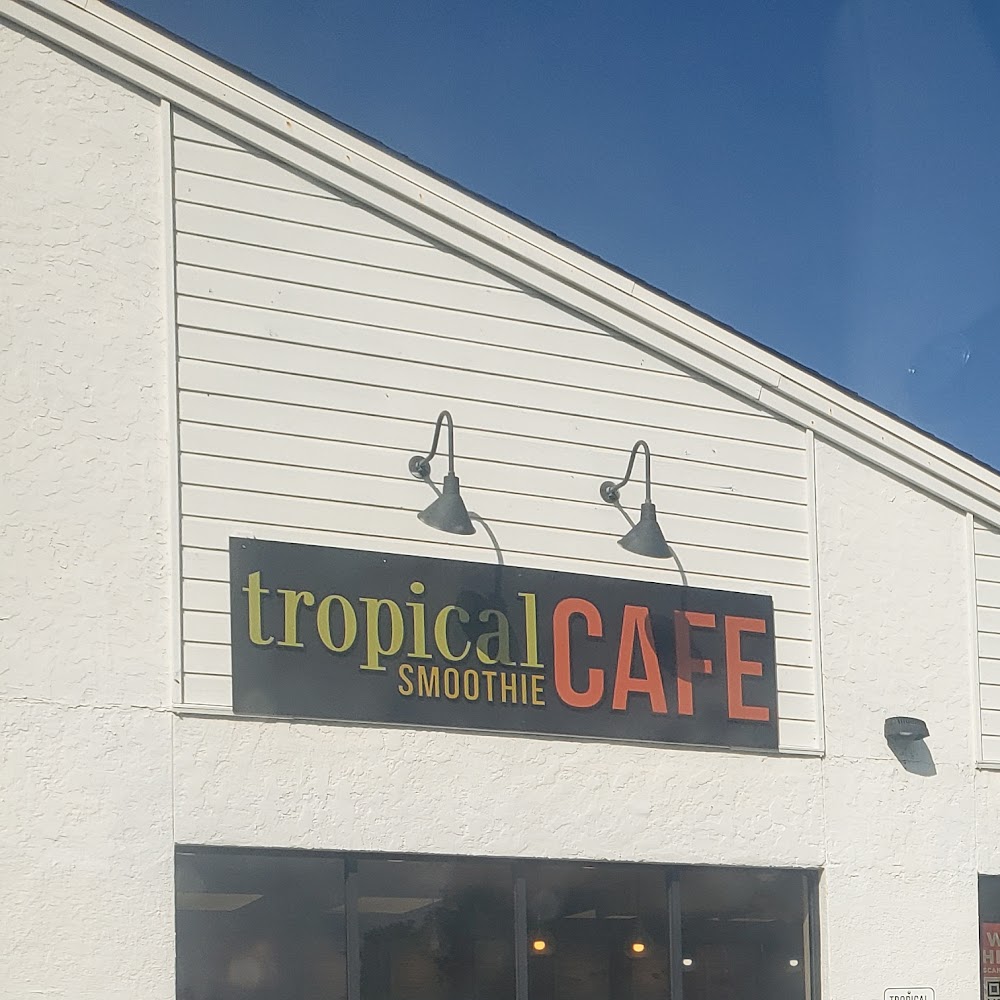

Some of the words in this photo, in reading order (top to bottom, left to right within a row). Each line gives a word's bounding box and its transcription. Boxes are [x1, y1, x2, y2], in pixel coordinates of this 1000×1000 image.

[242, 570, 545, 671] tropical
[552, 596, 770, 723] CAFE
[398, 662, 546, 706] SMOOTHIE
